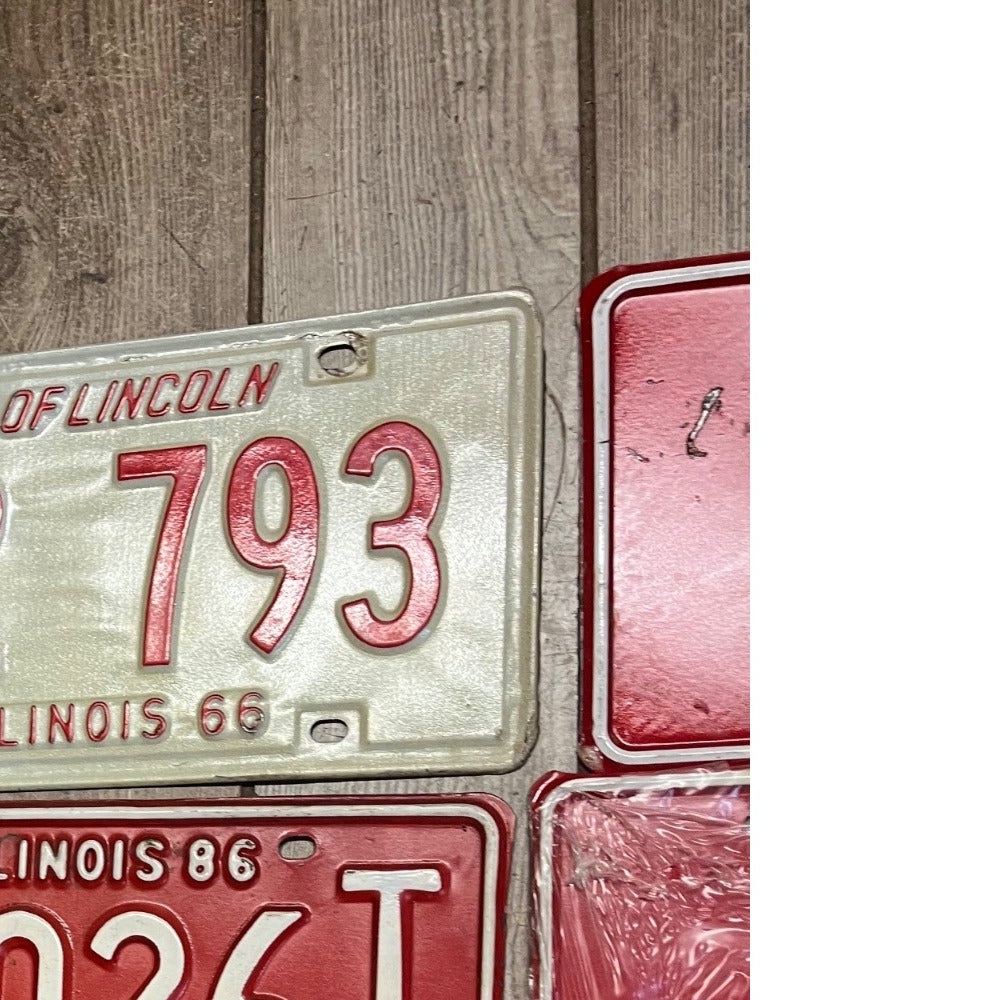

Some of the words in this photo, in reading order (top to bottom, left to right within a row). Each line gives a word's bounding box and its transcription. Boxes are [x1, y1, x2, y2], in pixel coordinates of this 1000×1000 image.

[0, 385, 67, 434] OF
[69, 360, 280, 426] LINCOLN
[117, 420, 444, 667] 793
[200, 691, 266, 738] 66
[187, 837, 257, 880] 86
